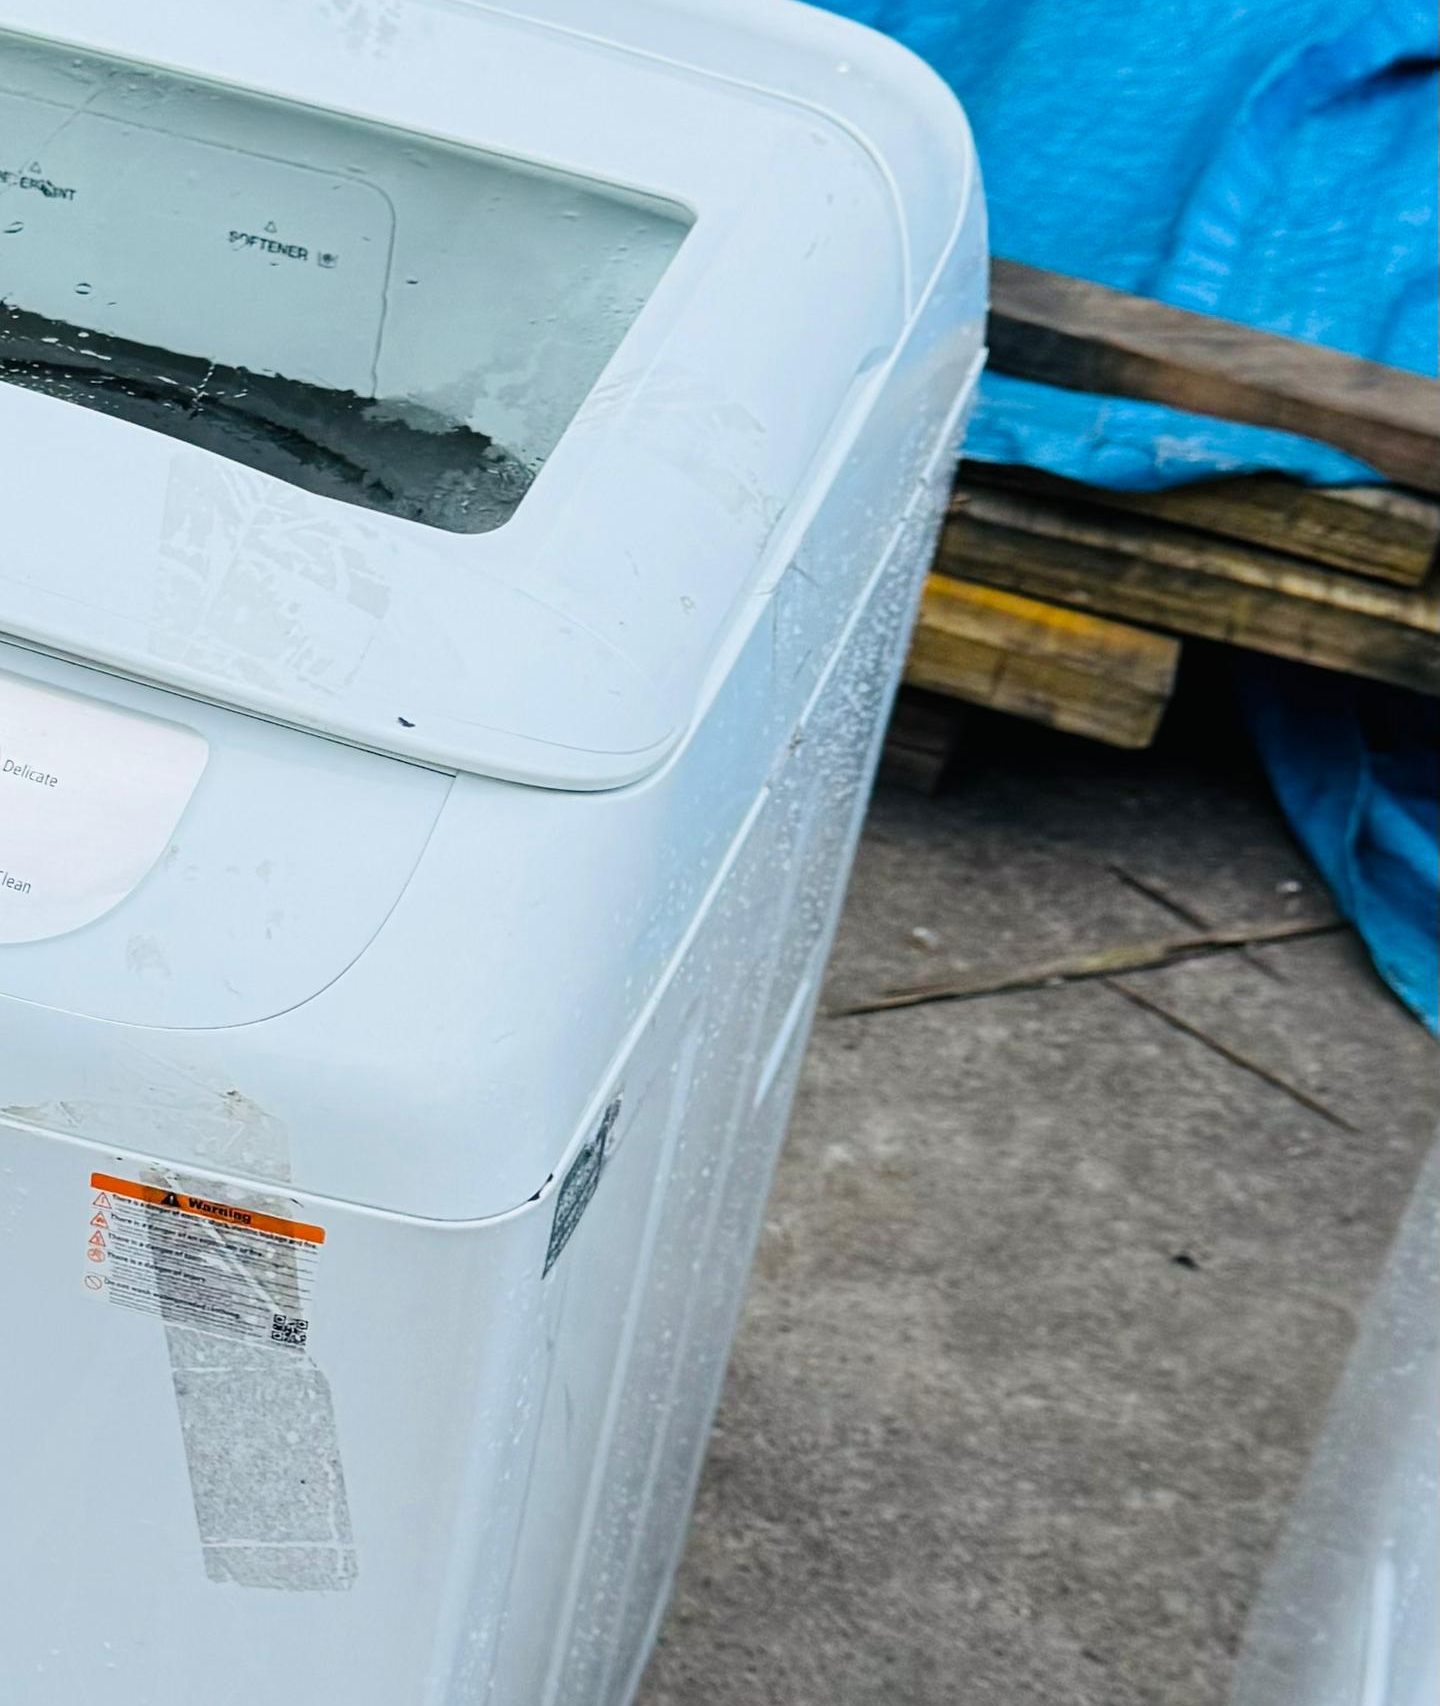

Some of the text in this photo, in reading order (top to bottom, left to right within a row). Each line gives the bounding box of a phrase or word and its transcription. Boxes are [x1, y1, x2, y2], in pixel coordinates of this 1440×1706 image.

[228, 230, 309, 261] SOFTENER
[2, 758, 59, 788] Delicate
[188, 1196, 252, 1225] Warning
